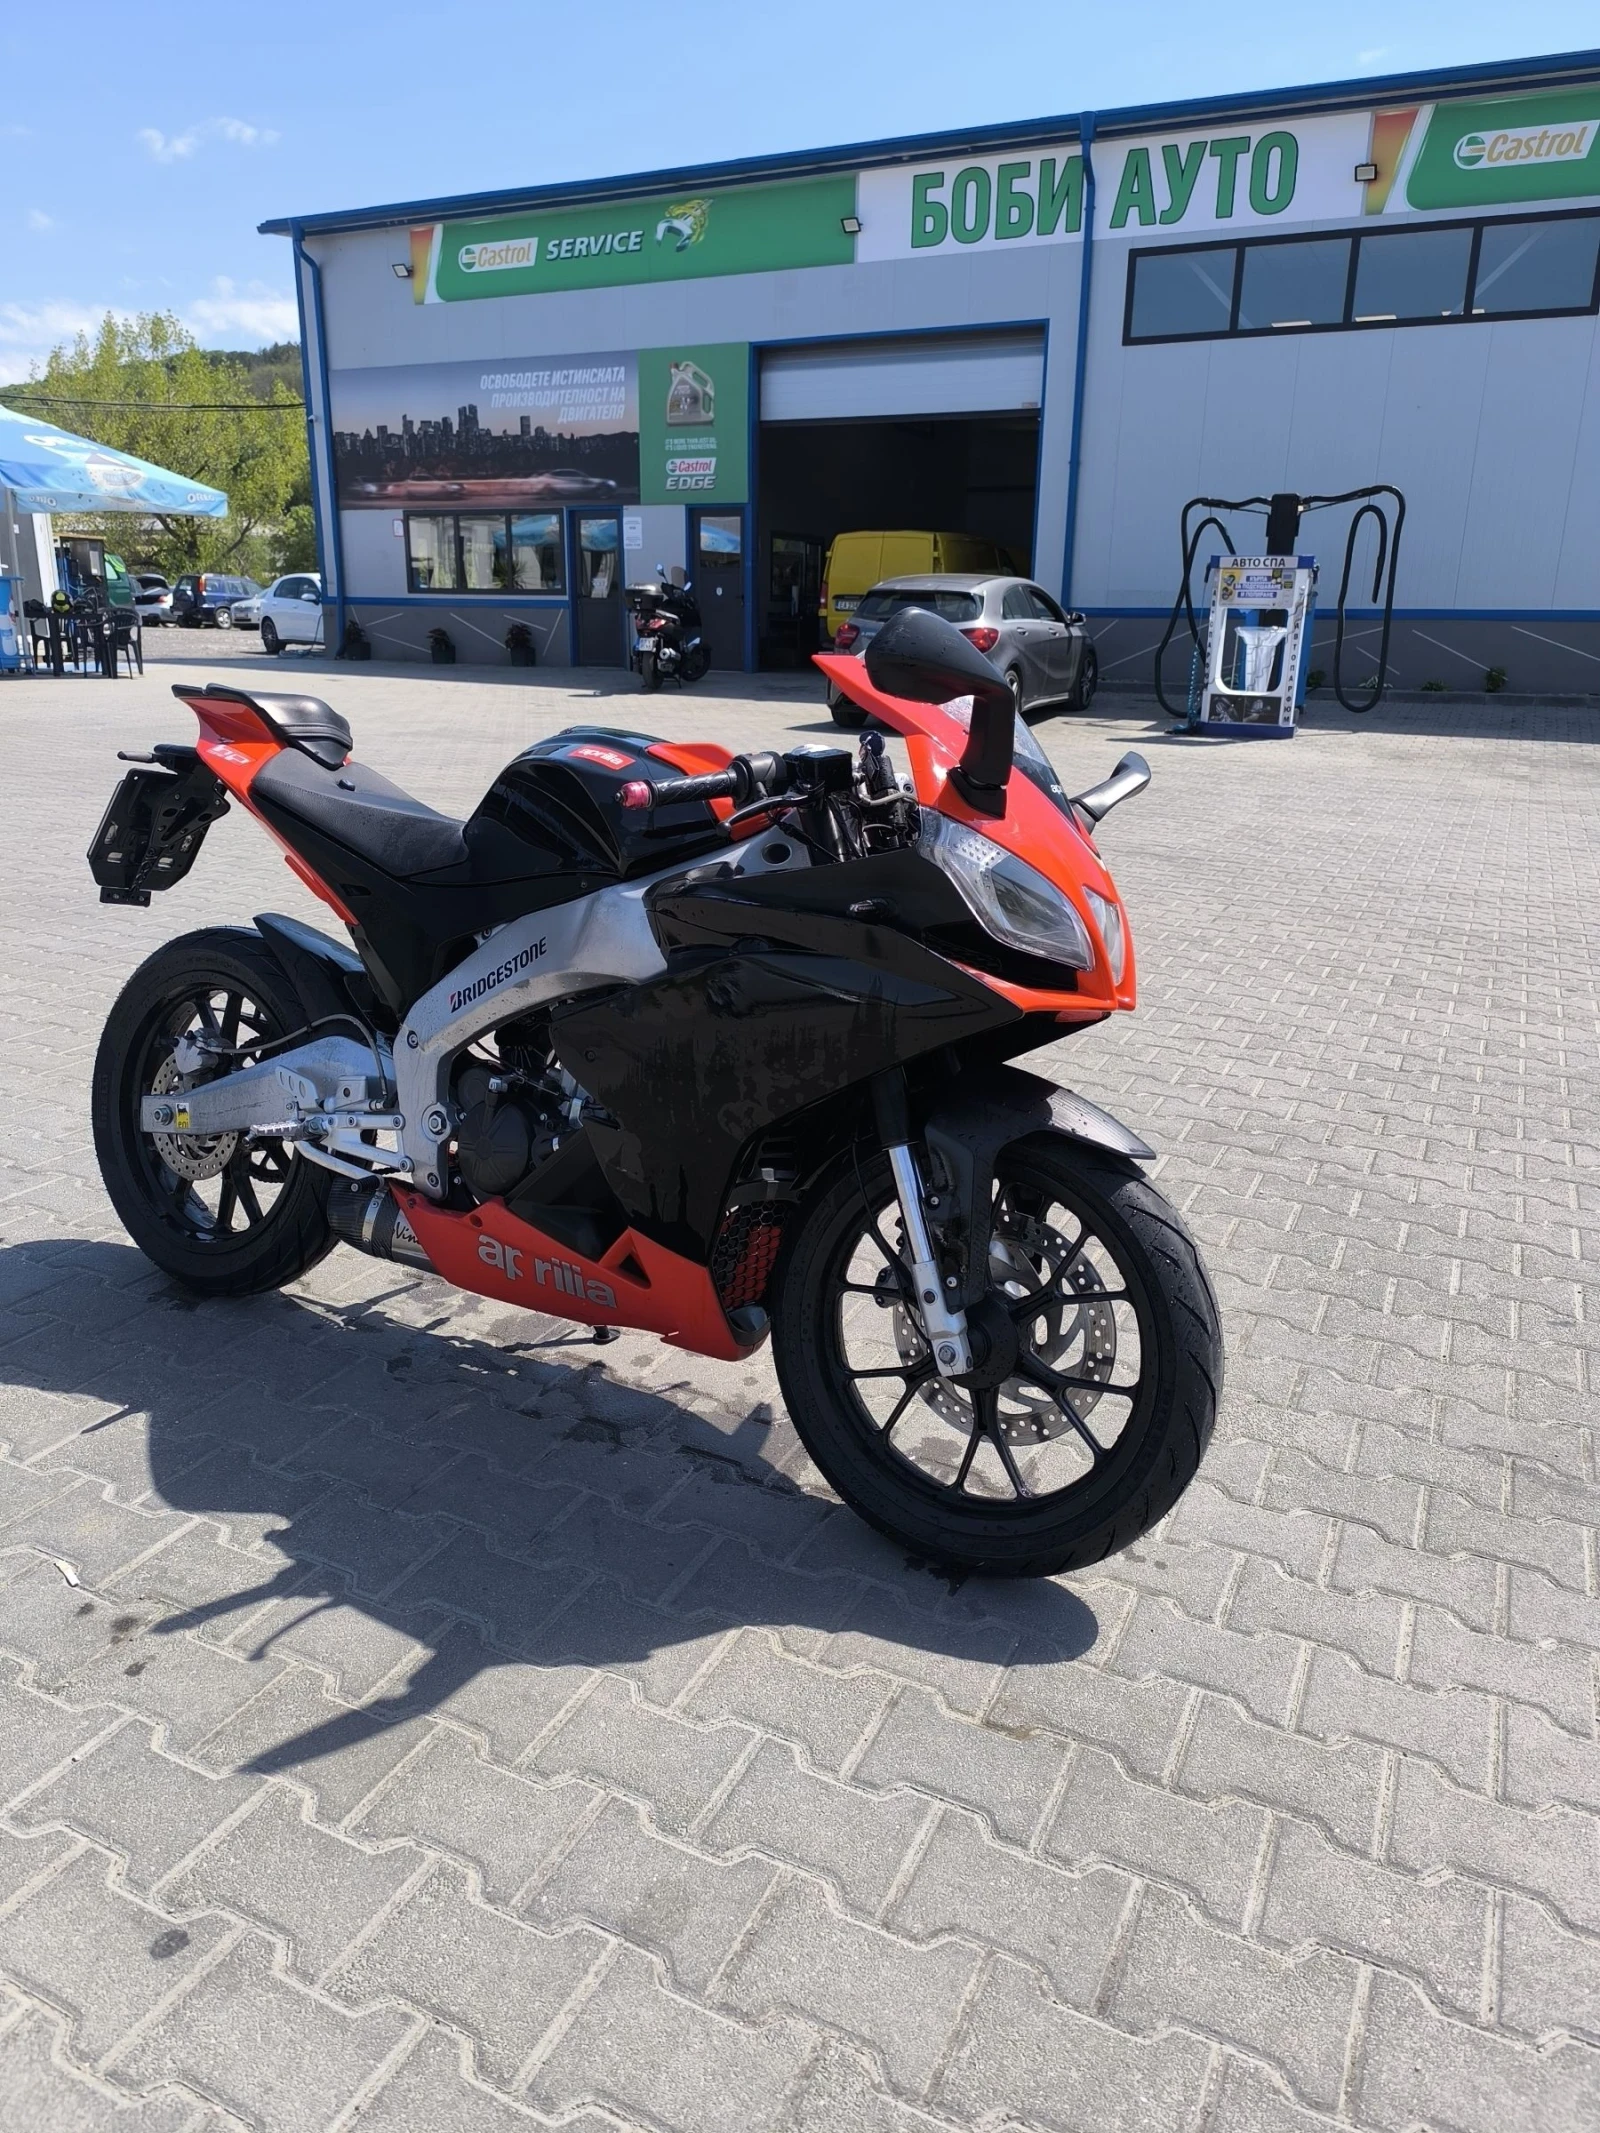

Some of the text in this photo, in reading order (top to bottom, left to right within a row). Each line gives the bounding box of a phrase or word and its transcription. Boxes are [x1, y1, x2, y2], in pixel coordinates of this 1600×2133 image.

[1486, 126, 1588, 163] Castrol
[911, 131, 1299, 248] БОБИ АУТО
[477, 230, 644, 268] Castrol SERVICE
[480, 366, 625, 390] ОСВОБОДЕТЕ ИСТИНСКАТА
[491, 386, 626, 408] ПРОИЗВОДИТЕЛНОСТ НА
[557, 404, 626, 424] ДВИГАТЕЛЯ
[678, 460, 712, 473] Castrol
[665, 476, 716, 490] EDGE
[1231, 558, 1286, 567] АВТО СПА
[450, 937, 547, 1014] BRIDGESTONE
